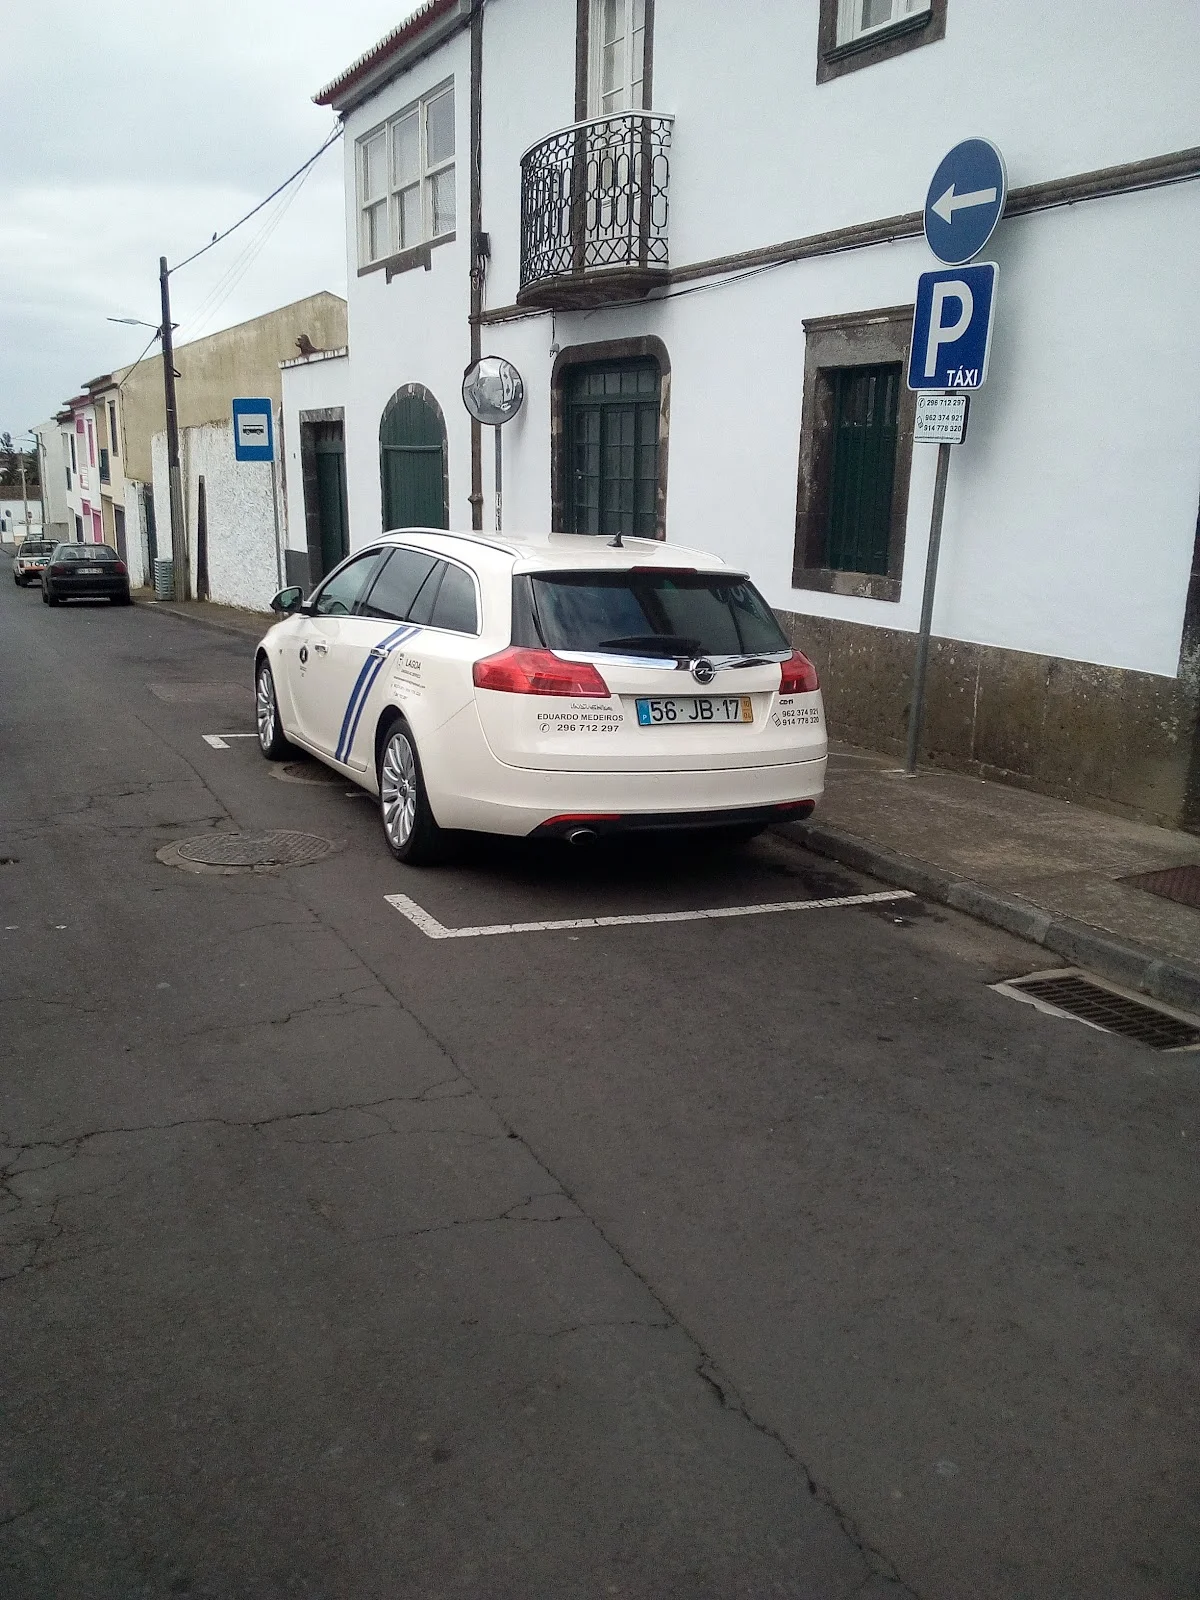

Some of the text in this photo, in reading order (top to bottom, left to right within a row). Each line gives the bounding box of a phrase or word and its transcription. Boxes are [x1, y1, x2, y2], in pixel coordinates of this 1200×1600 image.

[924, 280, 974, 378] P
[946, 365, 979, 387] TÁXI
[926, 399, 965, 407] 296 712 297
[580, 714, 624, 722] MEDEIROS
[557, 724, 576, 732] 296
[579, 724, 598, 732] 712
